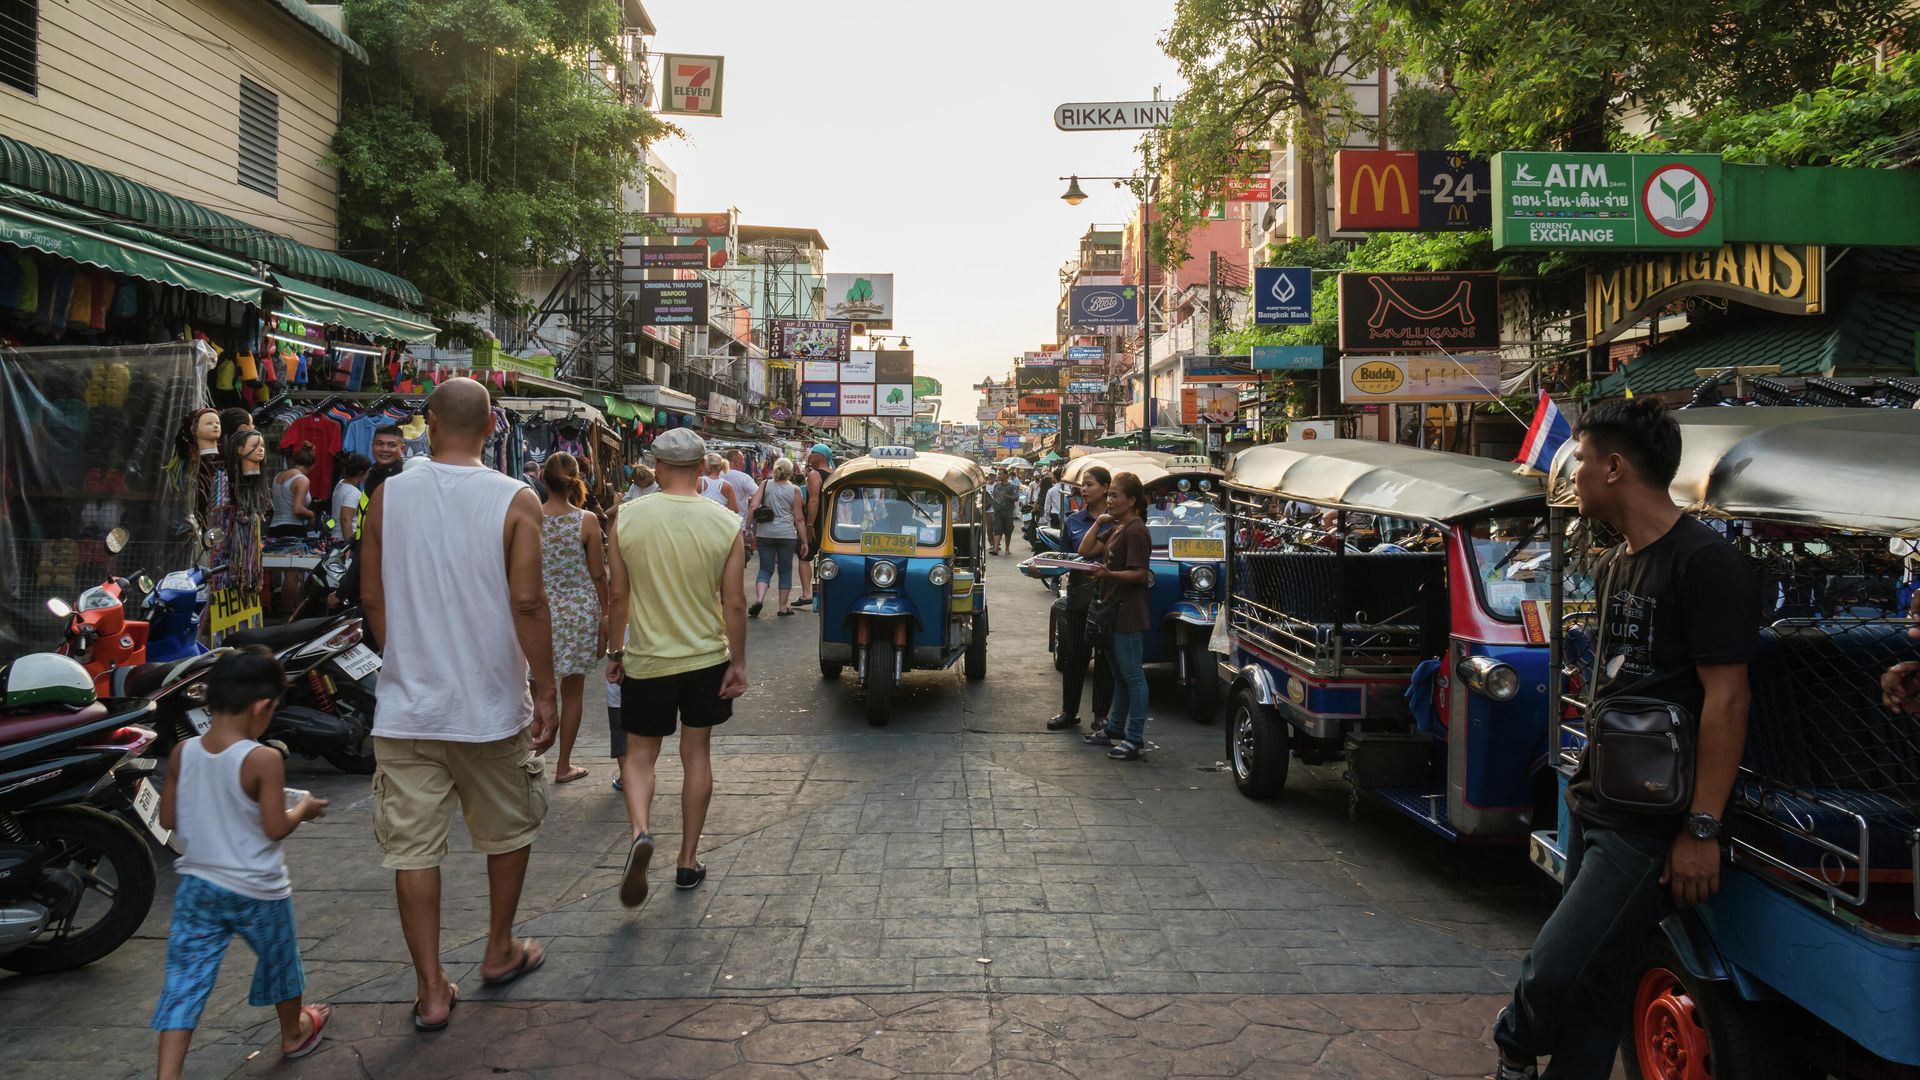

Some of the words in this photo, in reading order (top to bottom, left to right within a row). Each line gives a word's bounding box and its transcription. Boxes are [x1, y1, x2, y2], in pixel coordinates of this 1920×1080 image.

[678, 64, 711, 111] 7
[1062, 107, 1127, 126] RIKKA
[1134, 107, 1169, 124] INN
[1544, 163, 1609, 188] ATM
[1433, 173, 1477, 203] 24
[656, 217, 678, 227] THE
[680, 217, 703, 228] HUB
[1530, 229, 1614, 242] EXCHANGE
[1594, 244, 1804, 336] MULLIGANS
[1087, 296, 1118, 312] Boots
[770, 320, 782, 358] TATTOO
[1369, 326, 1476, 339] MULLIGANS
[839, 328, 848, 361] TATTOO
[1360, 368, 1396, 382] Buddy
[879, 447, 908, 456] TAXI
